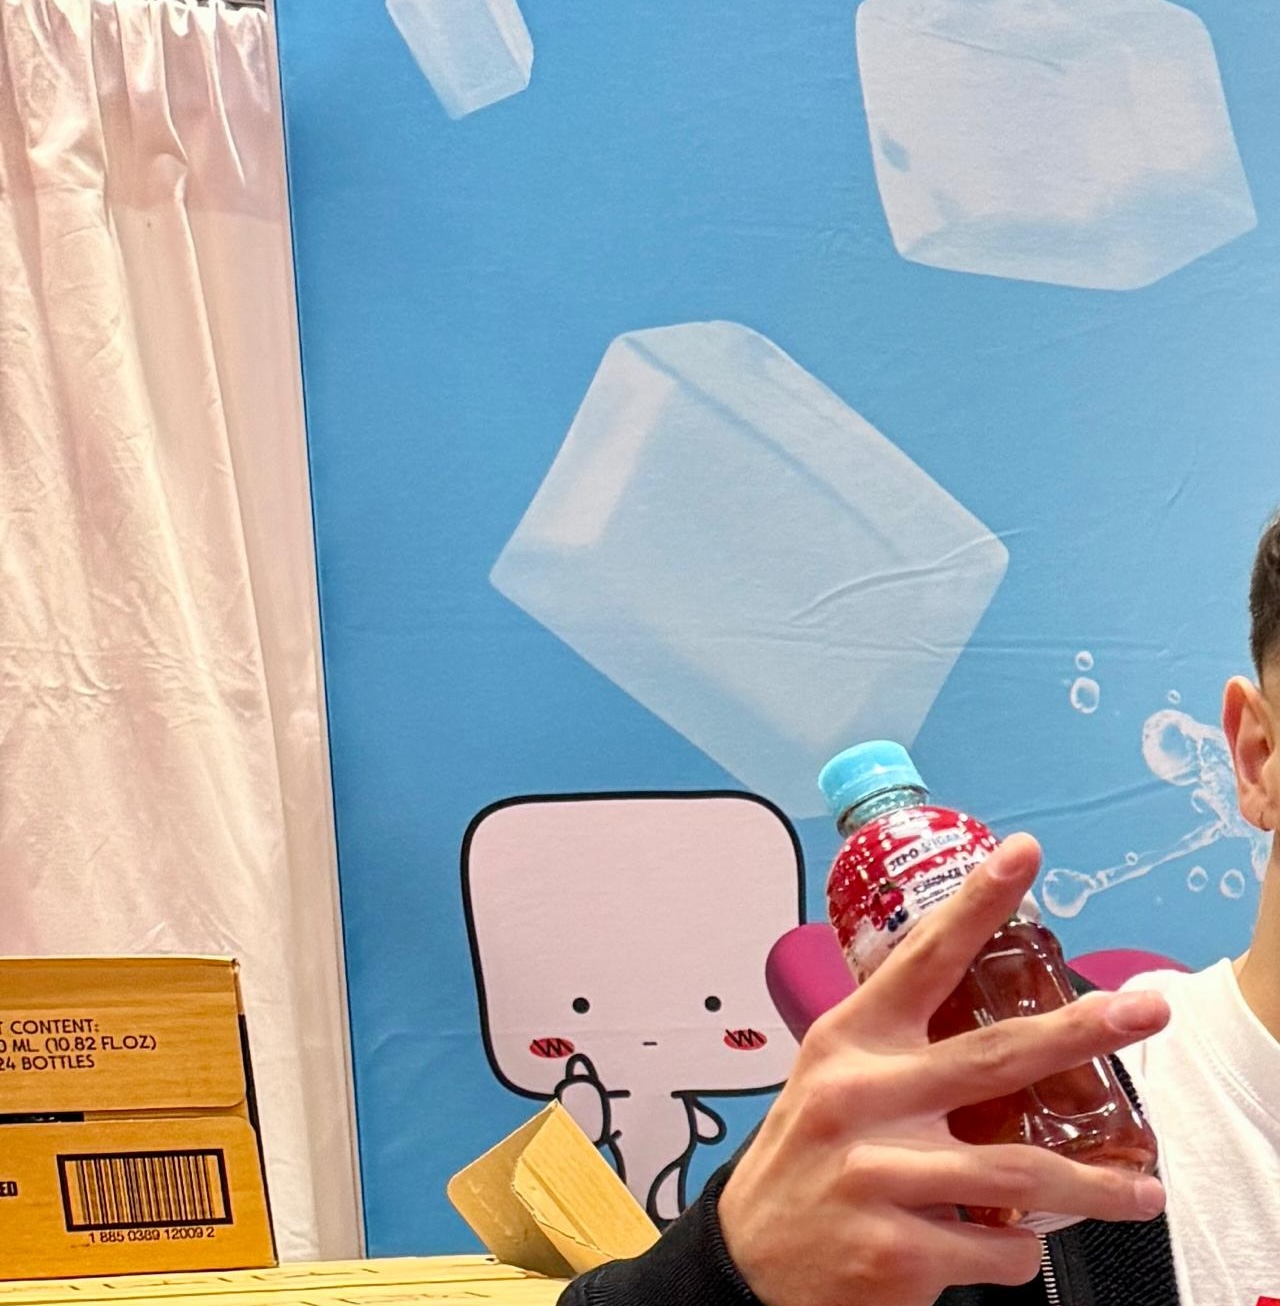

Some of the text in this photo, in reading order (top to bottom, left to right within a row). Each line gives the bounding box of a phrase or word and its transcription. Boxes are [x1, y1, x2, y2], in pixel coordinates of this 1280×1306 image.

[9, 1017, 99, 1035] CONTENT:
[44, 1035, 97, 1054] (10.82
[100, 1034, 156, 1050] FL.OZ)
